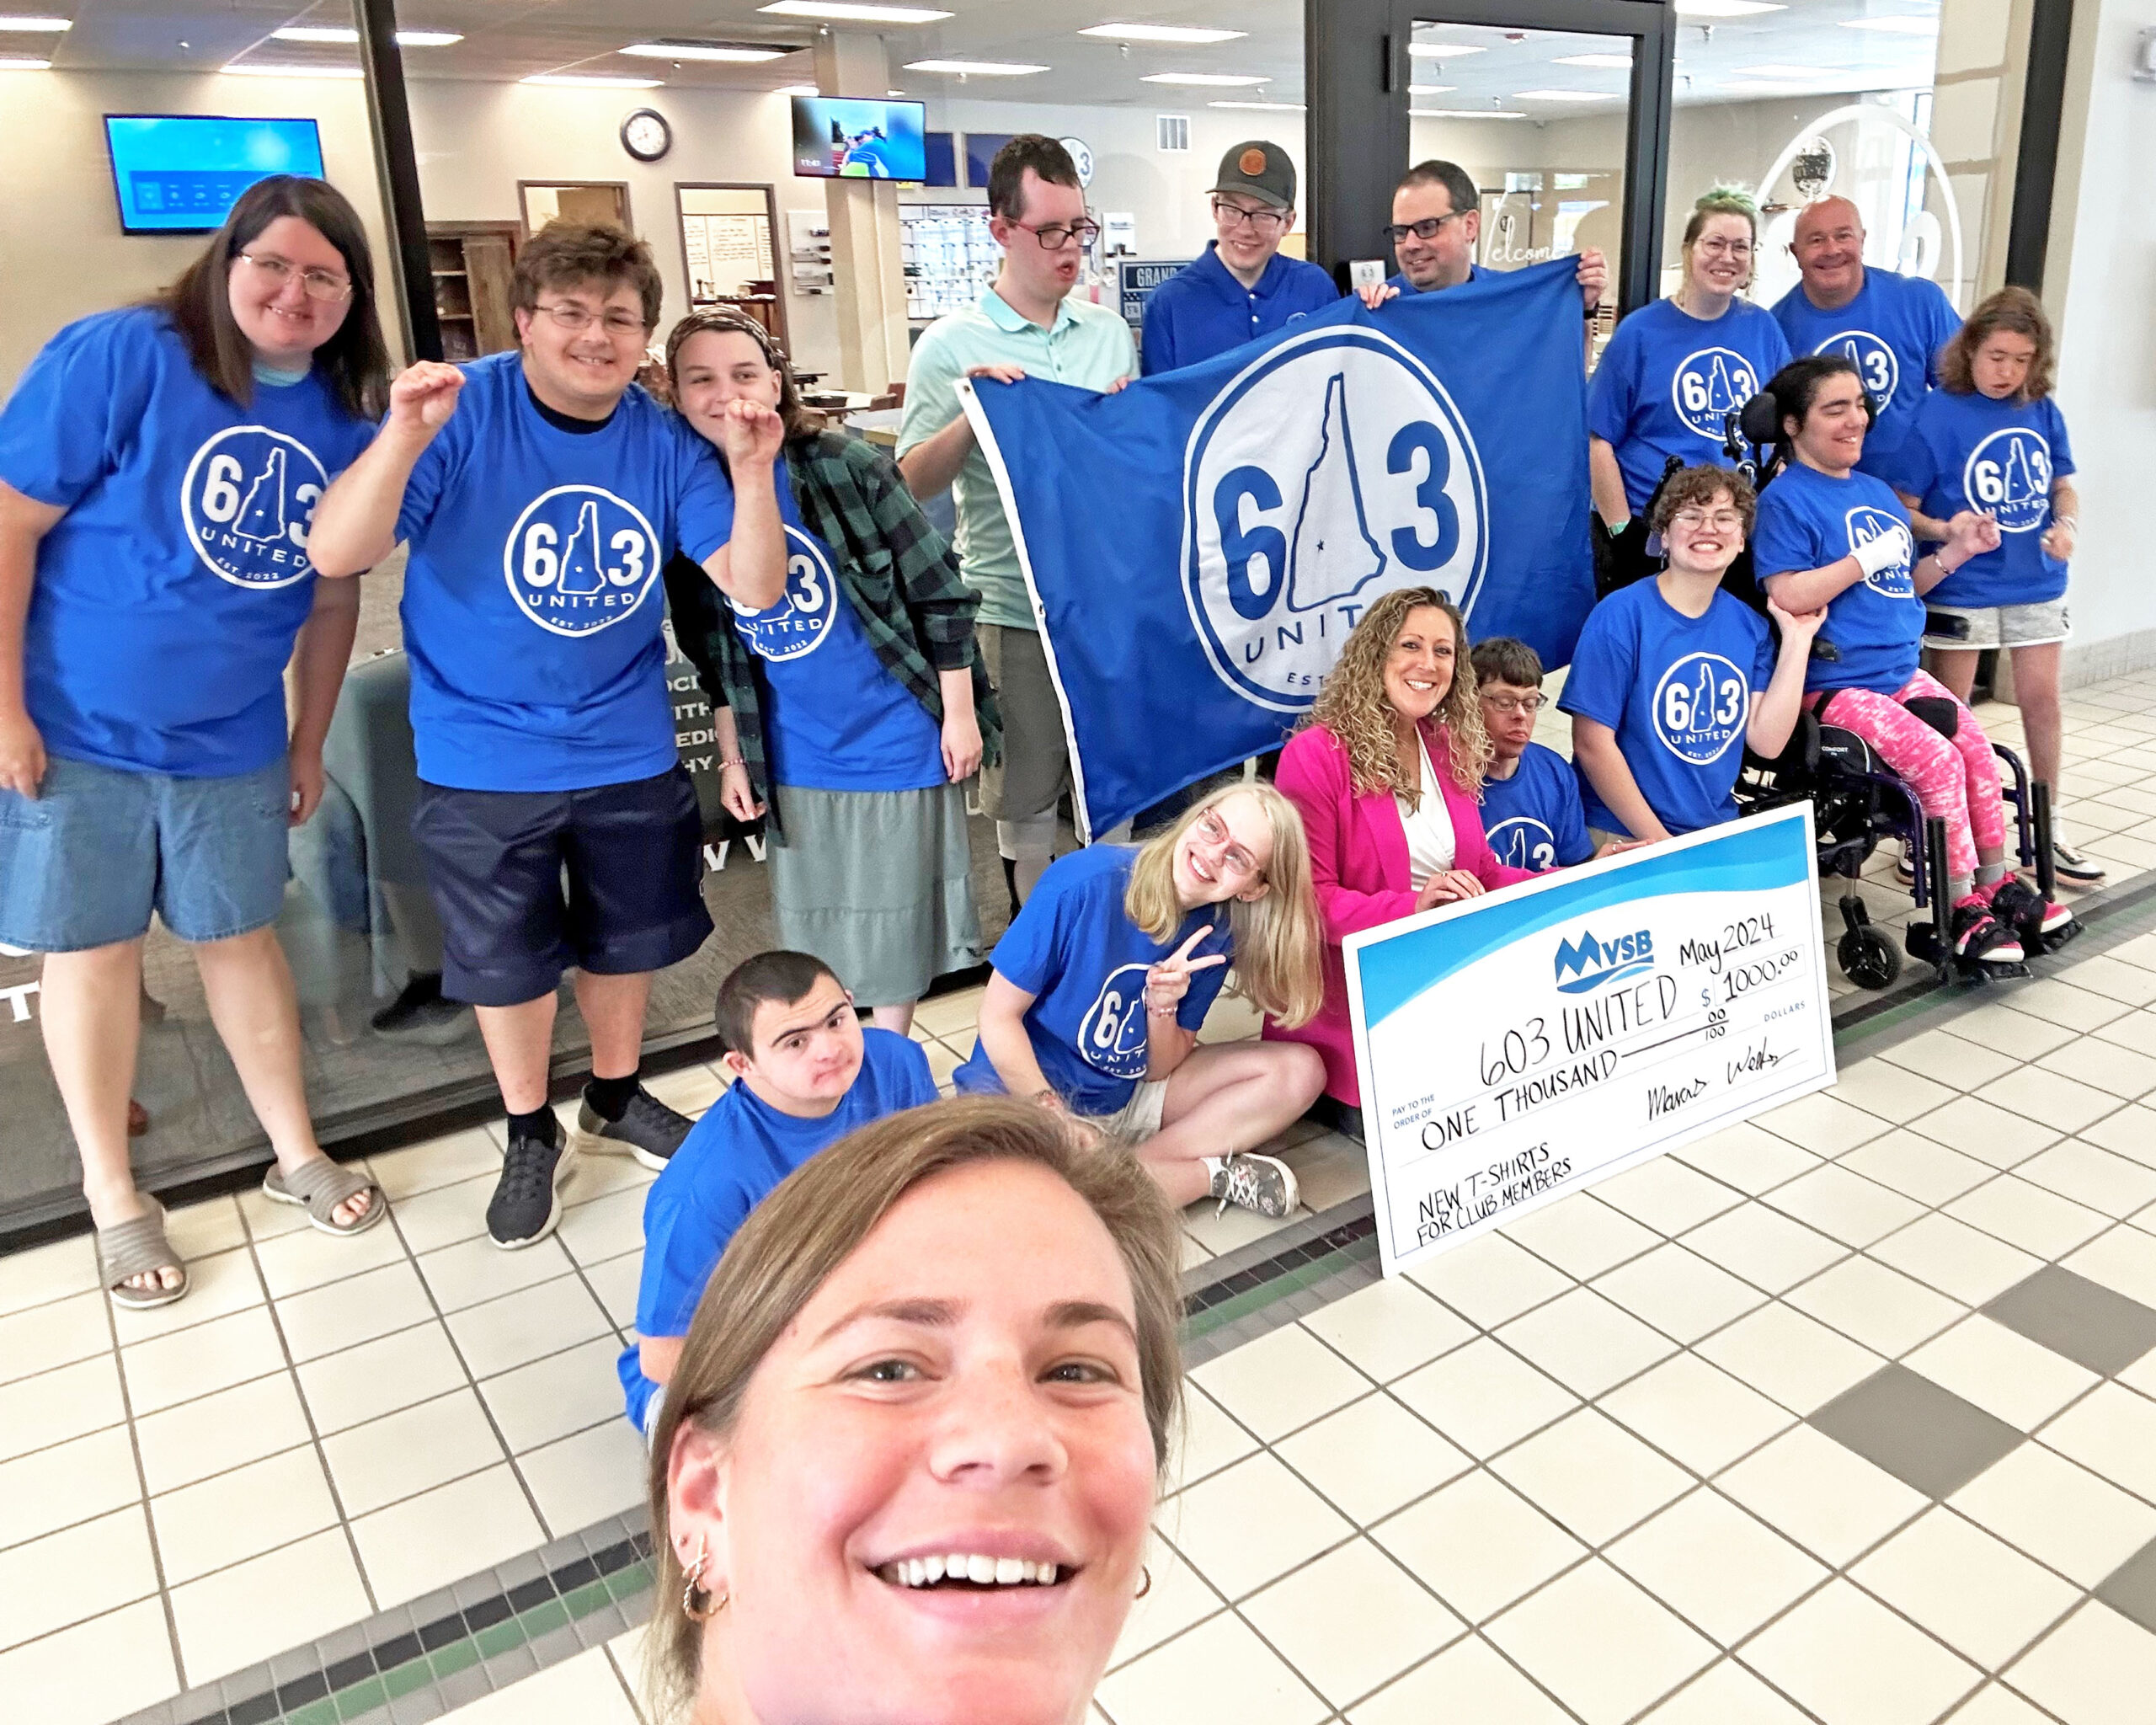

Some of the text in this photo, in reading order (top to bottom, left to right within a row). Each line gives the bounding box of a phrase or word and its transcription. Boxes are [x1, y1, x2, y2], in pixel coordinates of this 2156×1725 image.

[1483, 191, 1565, 268] elcom
[200, 526, 307, 568] UNITED
[528, 592, 636, 608] UNITED
[1670, 729, 1732, 745] UNITED
[1680, 912, 1775, 975] May 2024
[1481, 975, 1677, 1087] 603 UNITED
[1764, 1000, 1806, 1023] DOLLARS
[1090, 1048, 1145, 1063] UNIT
[1392, 1094, 1434, 1117] PAY TO THE
[1394, 1108, 1433, 1130] ORDER OF
[1421, 1049, 1618, 1151] ONE THOUSAND
[1417, 1157, 1572, 1247] FOR CLUB MEMBERS
[1419, 1141, 1550, 1223] NEW T-SHIRTS
